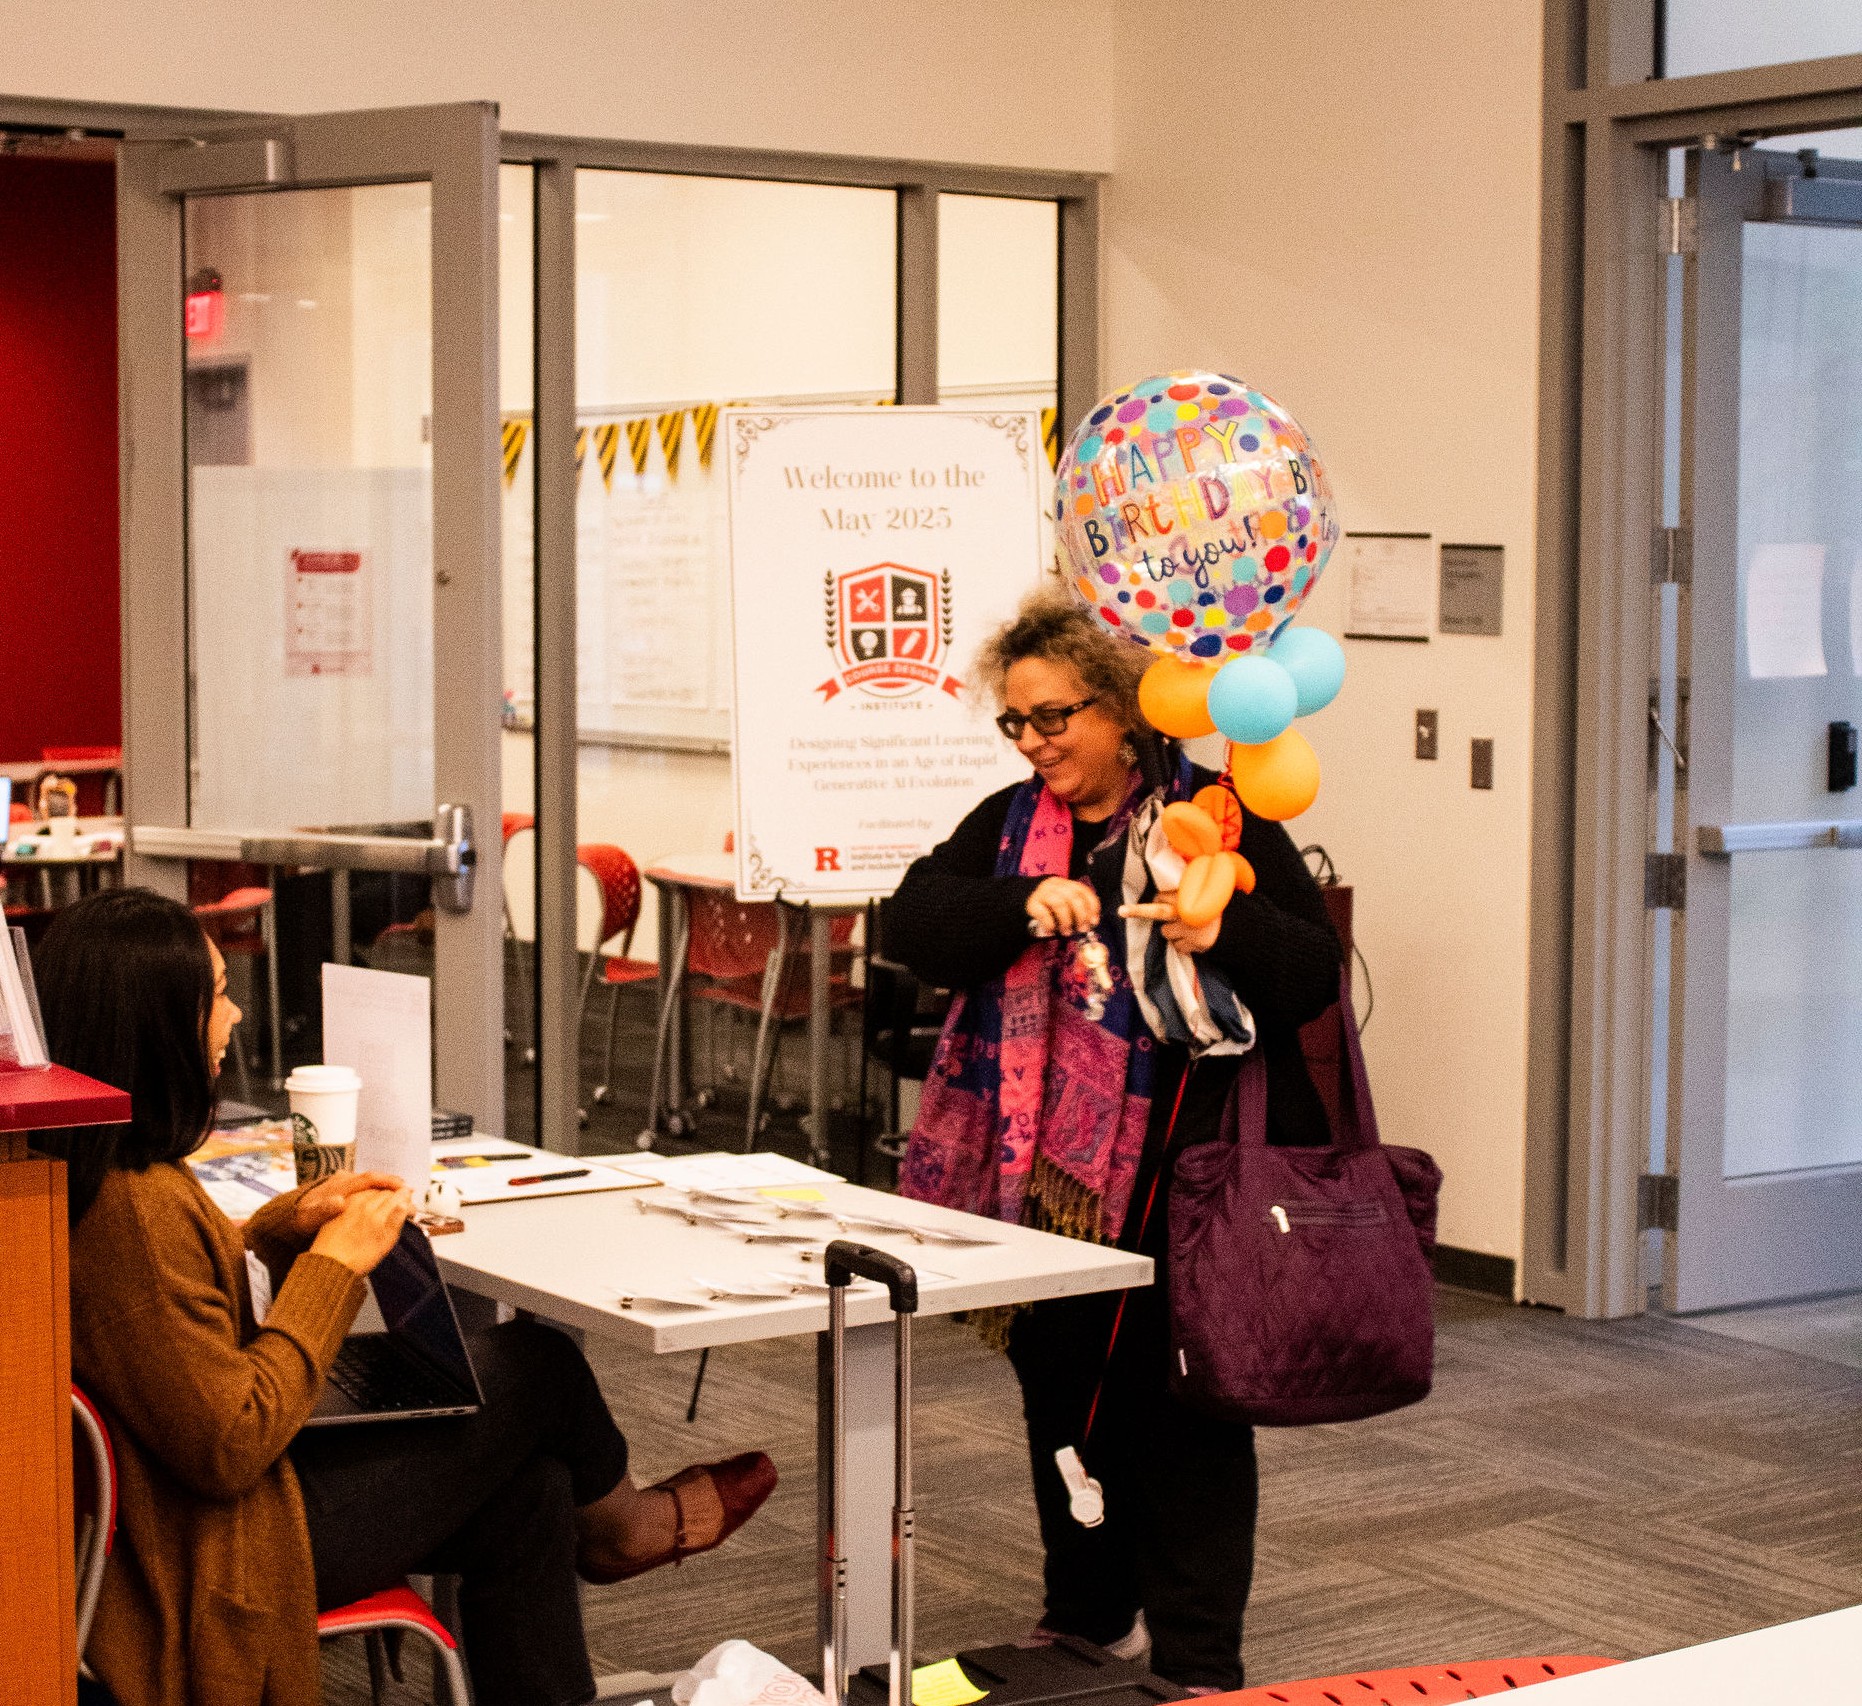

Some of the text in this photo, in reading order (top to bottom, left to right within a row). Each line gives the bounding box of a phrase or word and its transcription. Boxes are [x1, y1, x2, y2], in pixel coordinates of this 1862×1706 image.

[783, 462, 986, 490] Welcome to the
[1091, 420, 1239, 508] HAPPY
[819, 506, 953, 539] May 2025
[1136, 550, 1180, 582] to
[1182, 514, 1257, 589] you!
[860, 701, 923, 711] INSTITUTE
[790, 733, 996, 753] Designing Significant Learning
[787, 753, 998, 774] Experiences in an Age of Rapid
[813, 777, 888, 792] Generative
[909, 775, 975, 789] Evolution
[814, 846, 842, 872] R
